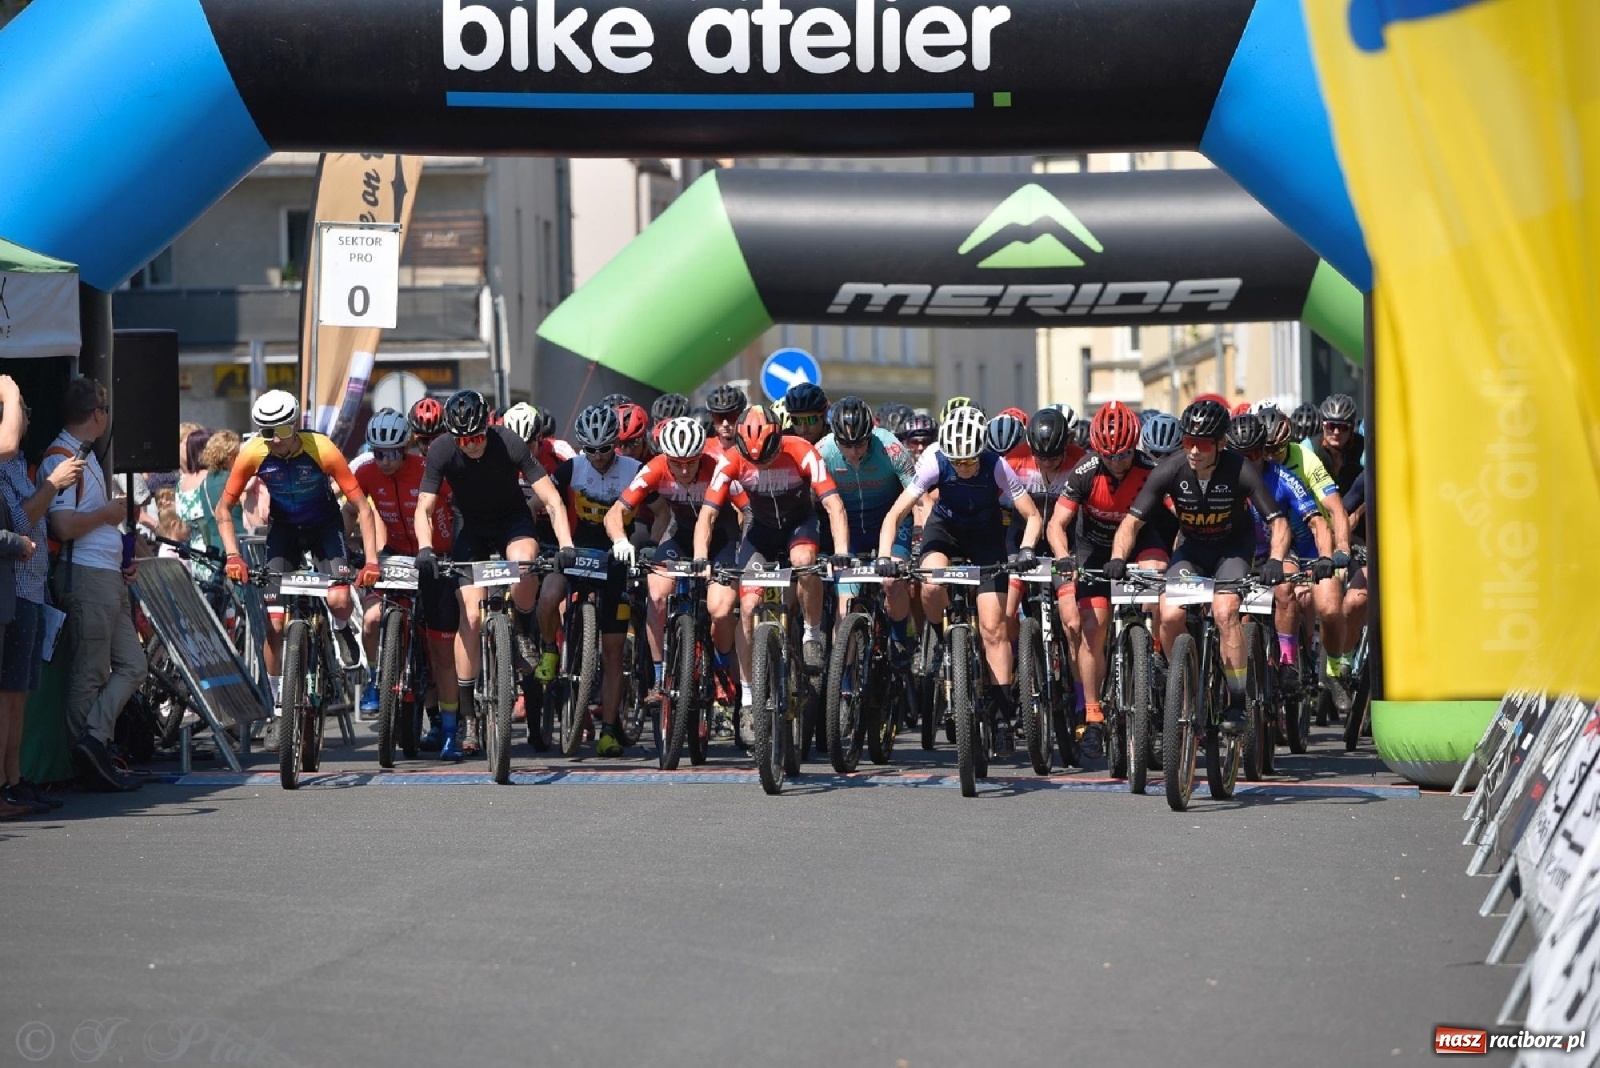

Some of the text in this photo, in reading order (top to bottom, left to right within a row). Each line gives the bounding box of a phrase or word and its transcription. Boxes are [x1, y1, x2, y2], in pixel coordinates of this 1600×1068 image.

[443, 0, 1012, 74] bike atelier
[338, 236, 382, 246] SEKTOR
[349, 252, 373, 263] PRO
[347, 285, 370, 317] 0
[827, 277, 1242, 316] MERIDA
[1180, 512, 1231, 526] RMF
[482, 568, 511, 579] 2154
[1480, 519, 1540, 652] bike
